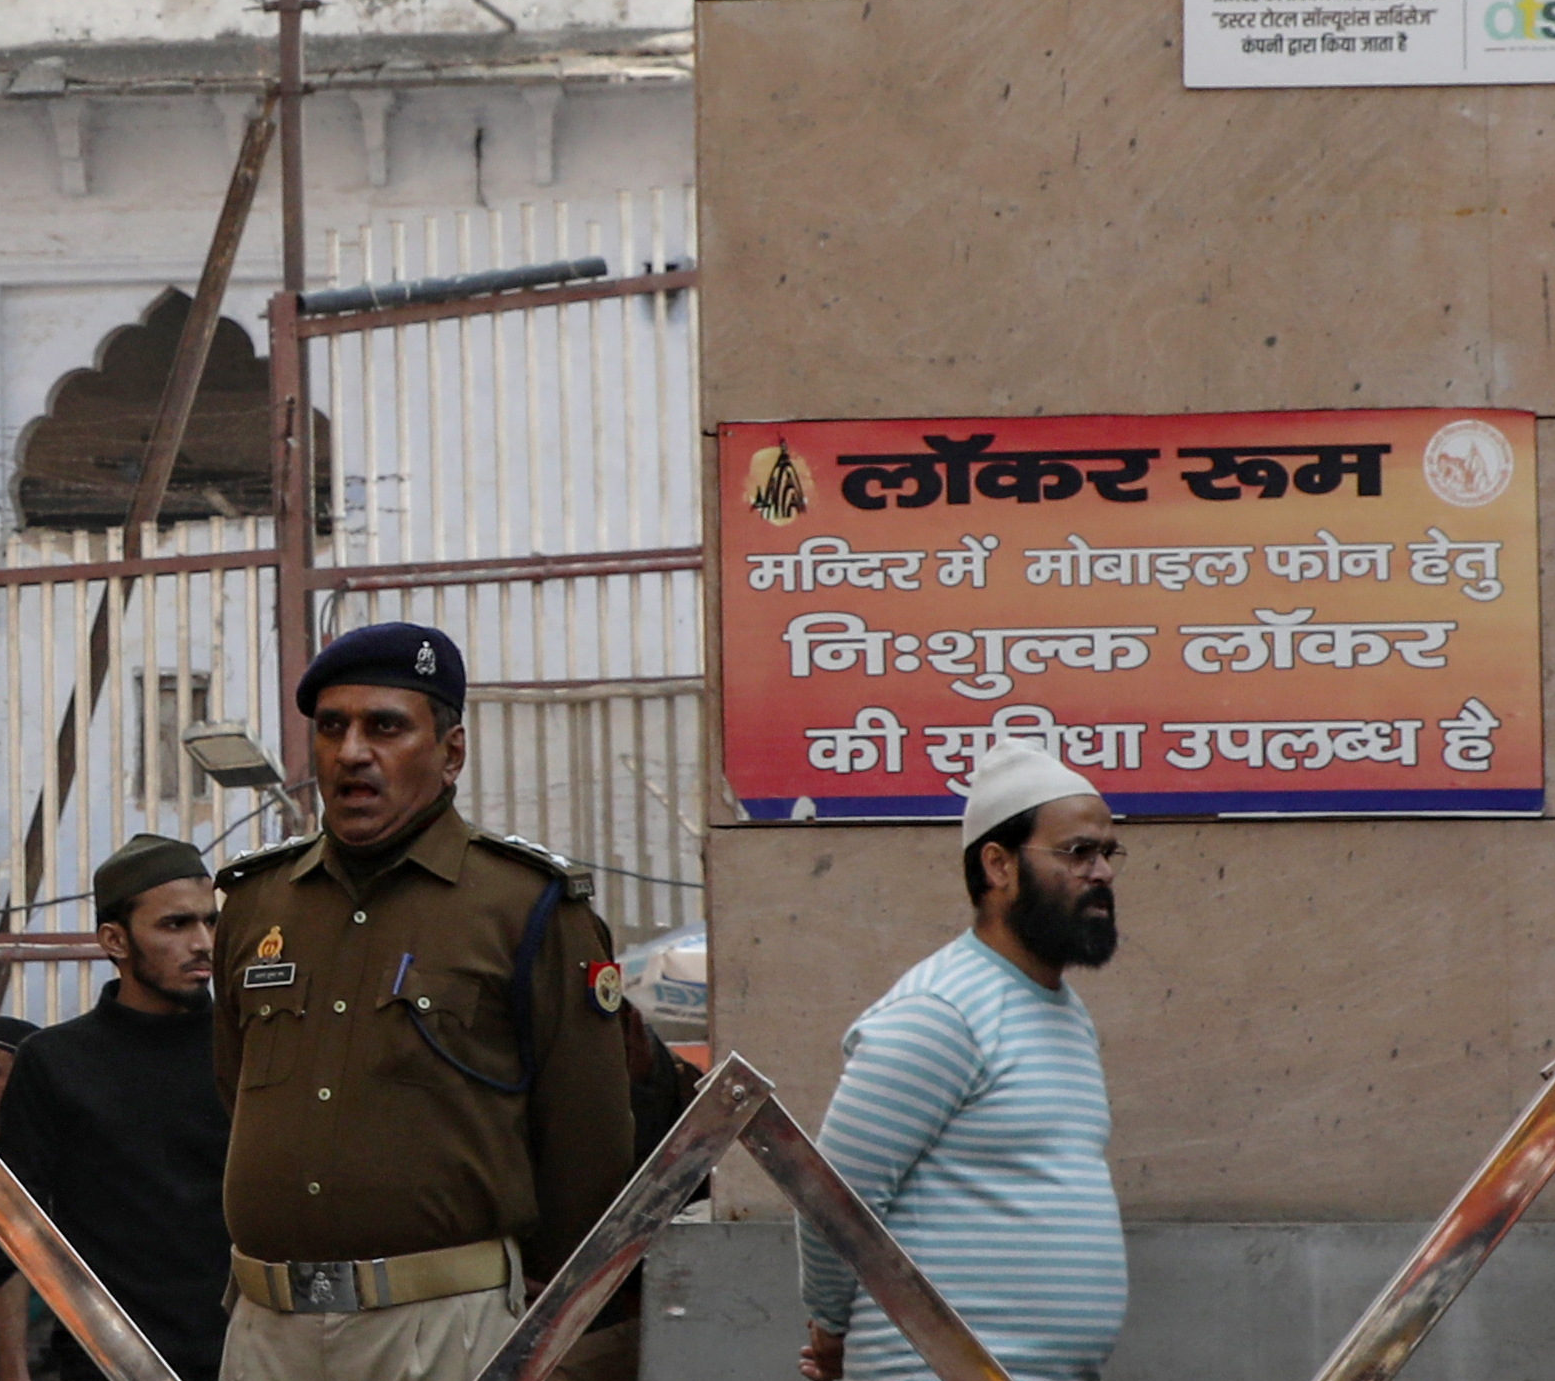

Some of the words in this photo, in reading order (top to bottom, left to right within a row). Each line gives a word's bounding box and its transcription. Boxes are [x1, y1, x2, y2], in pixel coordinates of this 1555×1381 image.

[1241, 33, 1284, 54] कंपनी
[1321, 33, 1355, 53] किया
[1360, 35, 1393, 52] जाता
[1396, 31, 1408, 52] है
[837, 433, 1160, 510] लॉकर
[1178, 442, 1392, 501] रूम
[747, 536, 926, 592] मन्दिर
[937, 534, 1000, 589] में
[1024, 534, 1254, 592] मोबाइल
[1265, 529, 1393, 583] फोन
[1408, 527, 1504, 601] हेतु
[1180, 609, 1456, 674] लॉकर
[805, 707, 907, 774] की
[1164, 719, 1422, 771] उपलब्ध
[1441, 698, 1500, 771] है
